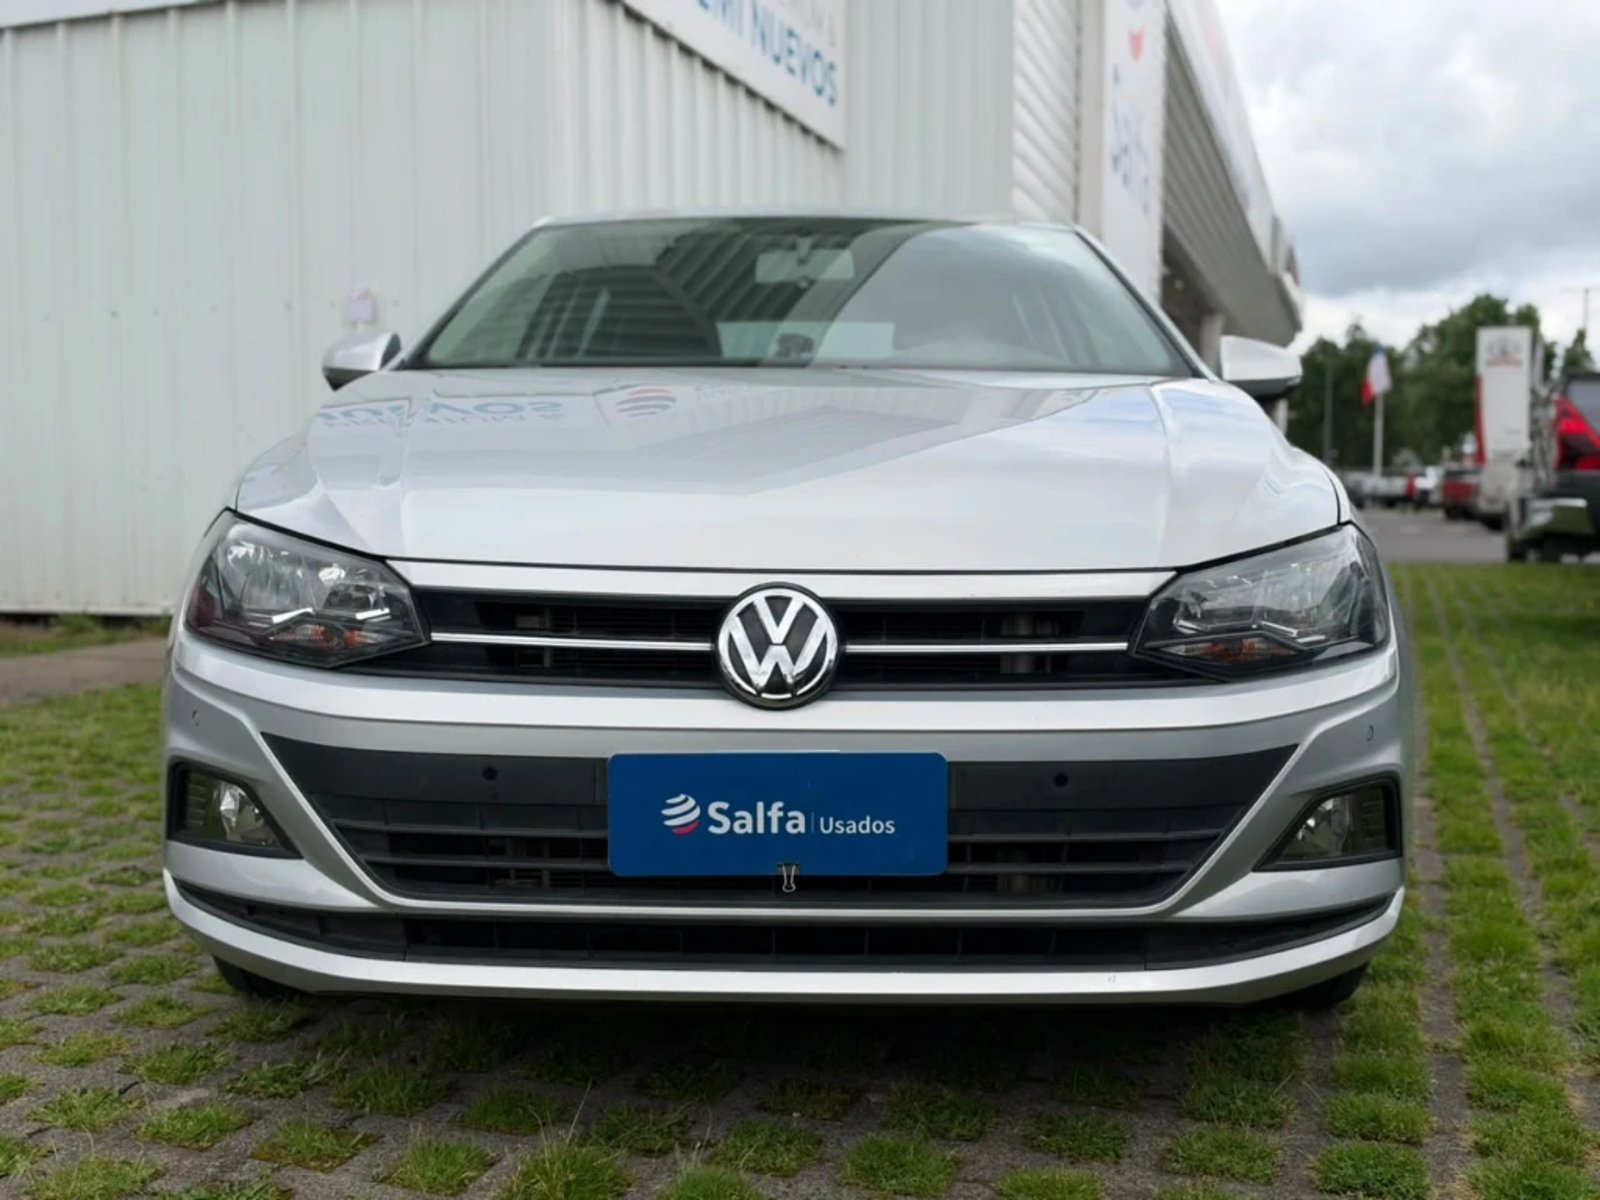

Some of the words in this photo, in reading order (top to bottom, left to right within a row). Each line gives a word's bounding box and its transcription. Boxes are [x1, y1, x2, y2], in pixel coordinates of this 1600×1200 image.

[751, 0, 837, 106] NUEVOS
[724, 592, 831, 692] VW
[707, 801, 806, 835] Salfa
[819, 815, 896, 835] Usados
